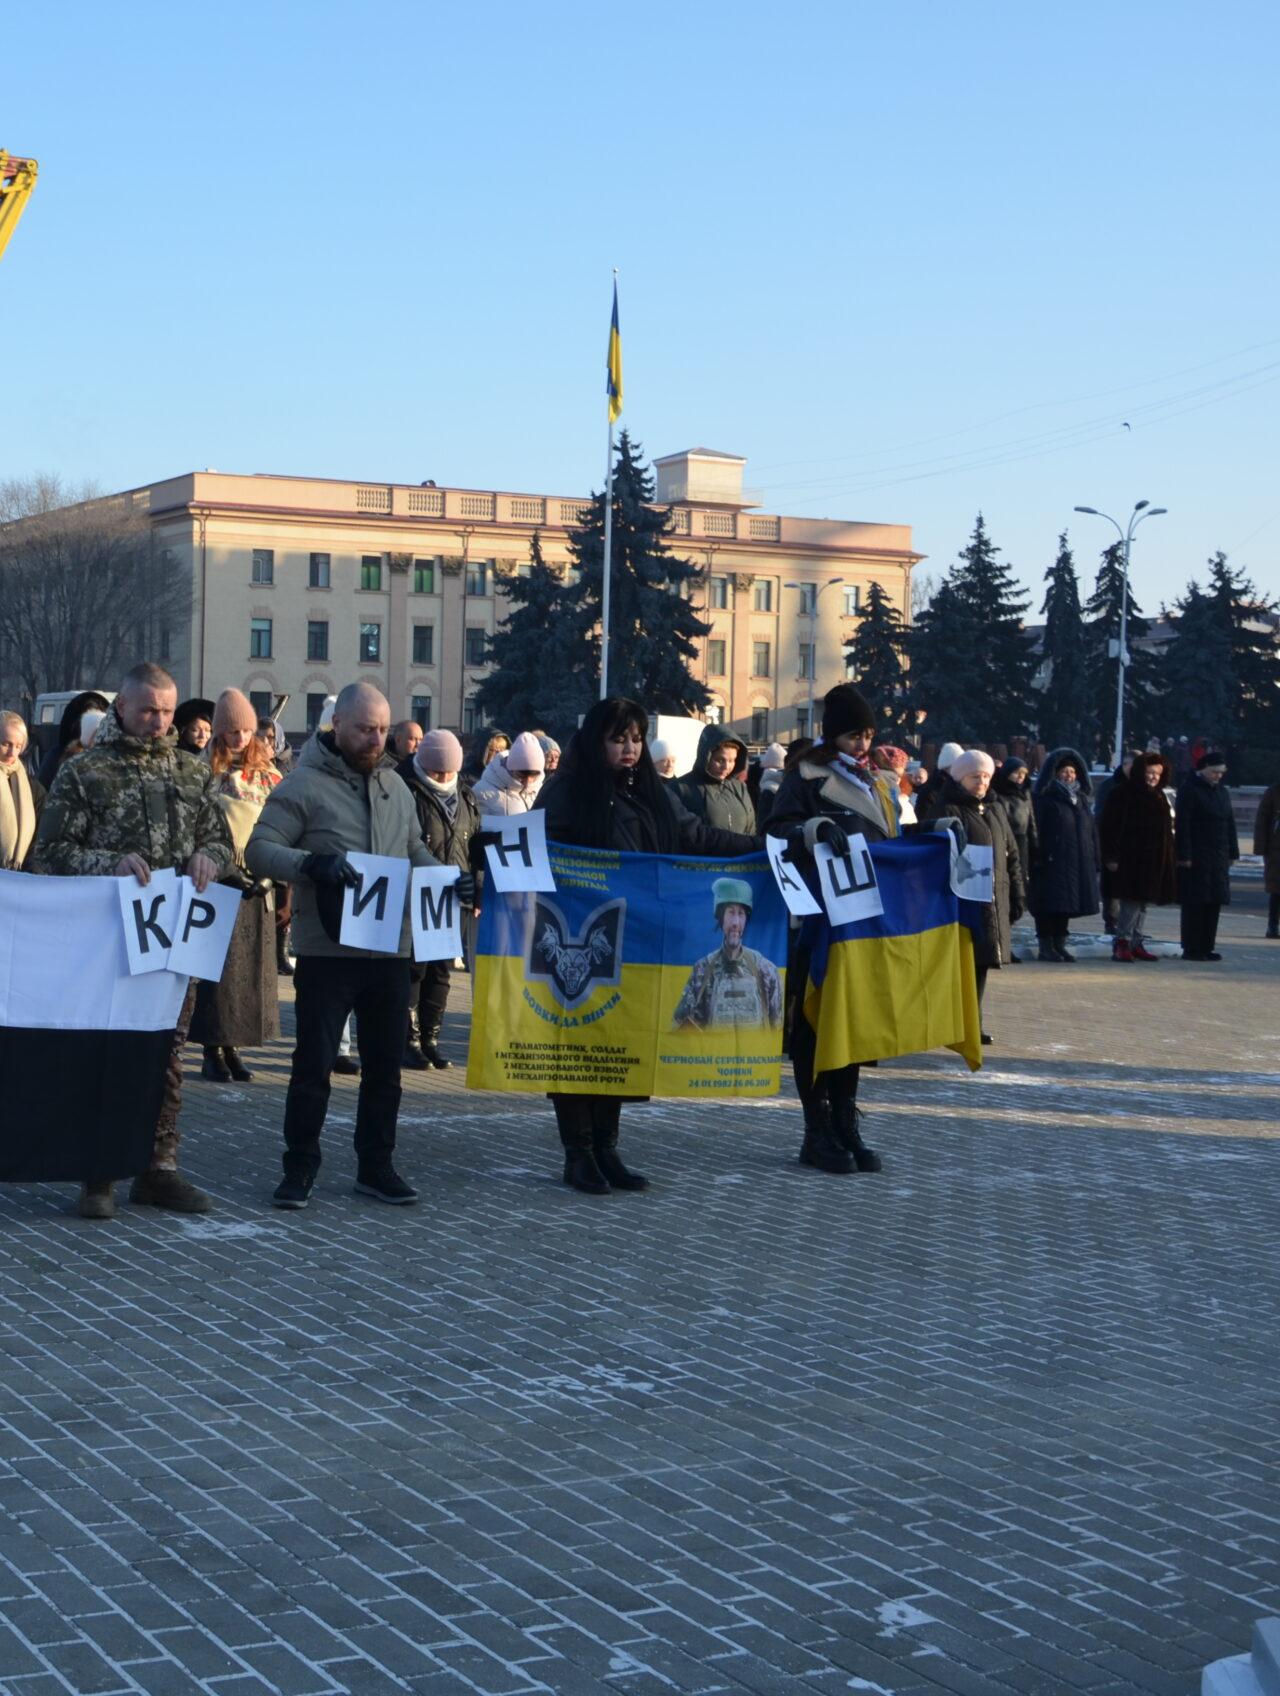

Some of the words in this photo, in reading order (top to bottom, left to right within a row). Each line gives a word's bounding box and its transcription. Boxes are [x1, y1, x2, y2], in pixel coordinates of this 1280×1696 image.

[494, 827, 533, 867] Н
[775, 854, 800, 891] А
[826, 850, 877, 897] Ш
[353, 872, 389, 920] И
[421, 885, 454, 931] М
[132, 894, 172, 954] К
[182, 898, 216, 943] Р
[591, 1045, 627, 1055] СОЛДАТ
